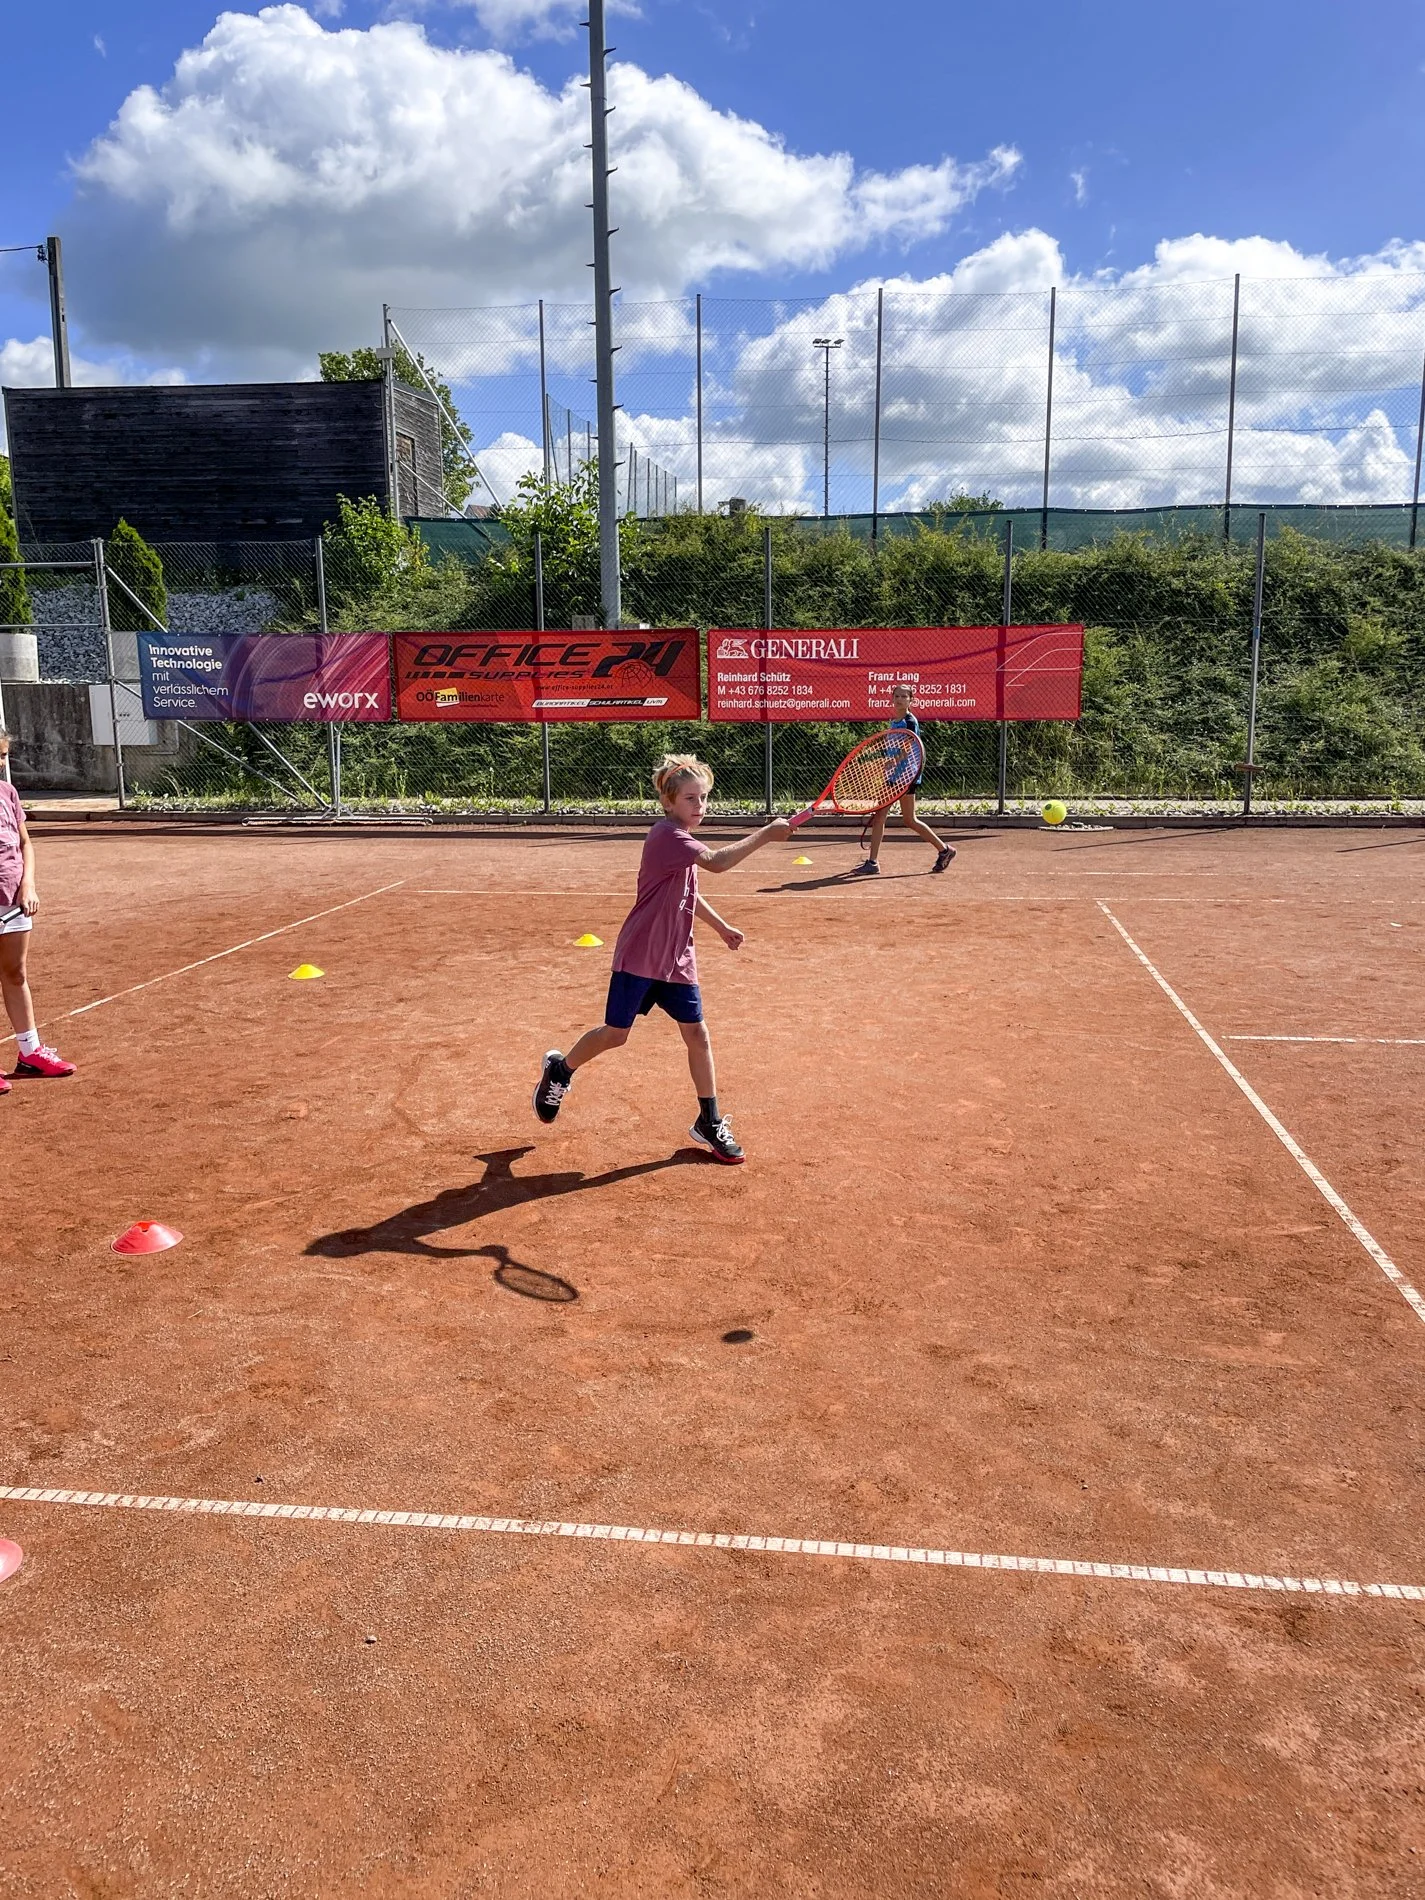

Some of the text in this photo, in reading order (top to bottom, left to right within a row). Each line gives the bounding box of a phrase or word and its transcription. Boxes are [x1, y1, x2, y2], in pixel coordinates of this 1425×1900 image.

[149, 644, 212, 656] Innovative
[750, 638, 860, 659] GENERALI
[151, 658, 222, 672] Technologie
[413, 640, 686, 678] OFFICE 24
[152, 671, 170, 681] mit
[717, 672, 791, 682] Reinhard Schütz
[868, 671, 920, 682] Franz Lang
[153, 684, 229, 696] verlässlichem
[717, 686, 813, 695] M +43 676 8252 1834
[868, 685, 877, 695] M
[919, 684, 942, 694] 8252
[946, 684, 967, 694] 1831
[153, 696, 198, 708] Service.
[303, 692, 379, 709] eworx
[717, 698, 850, 710] reinhard.schuetz@generali.com
[868, 698, 976, 709] franz.@generali.com
